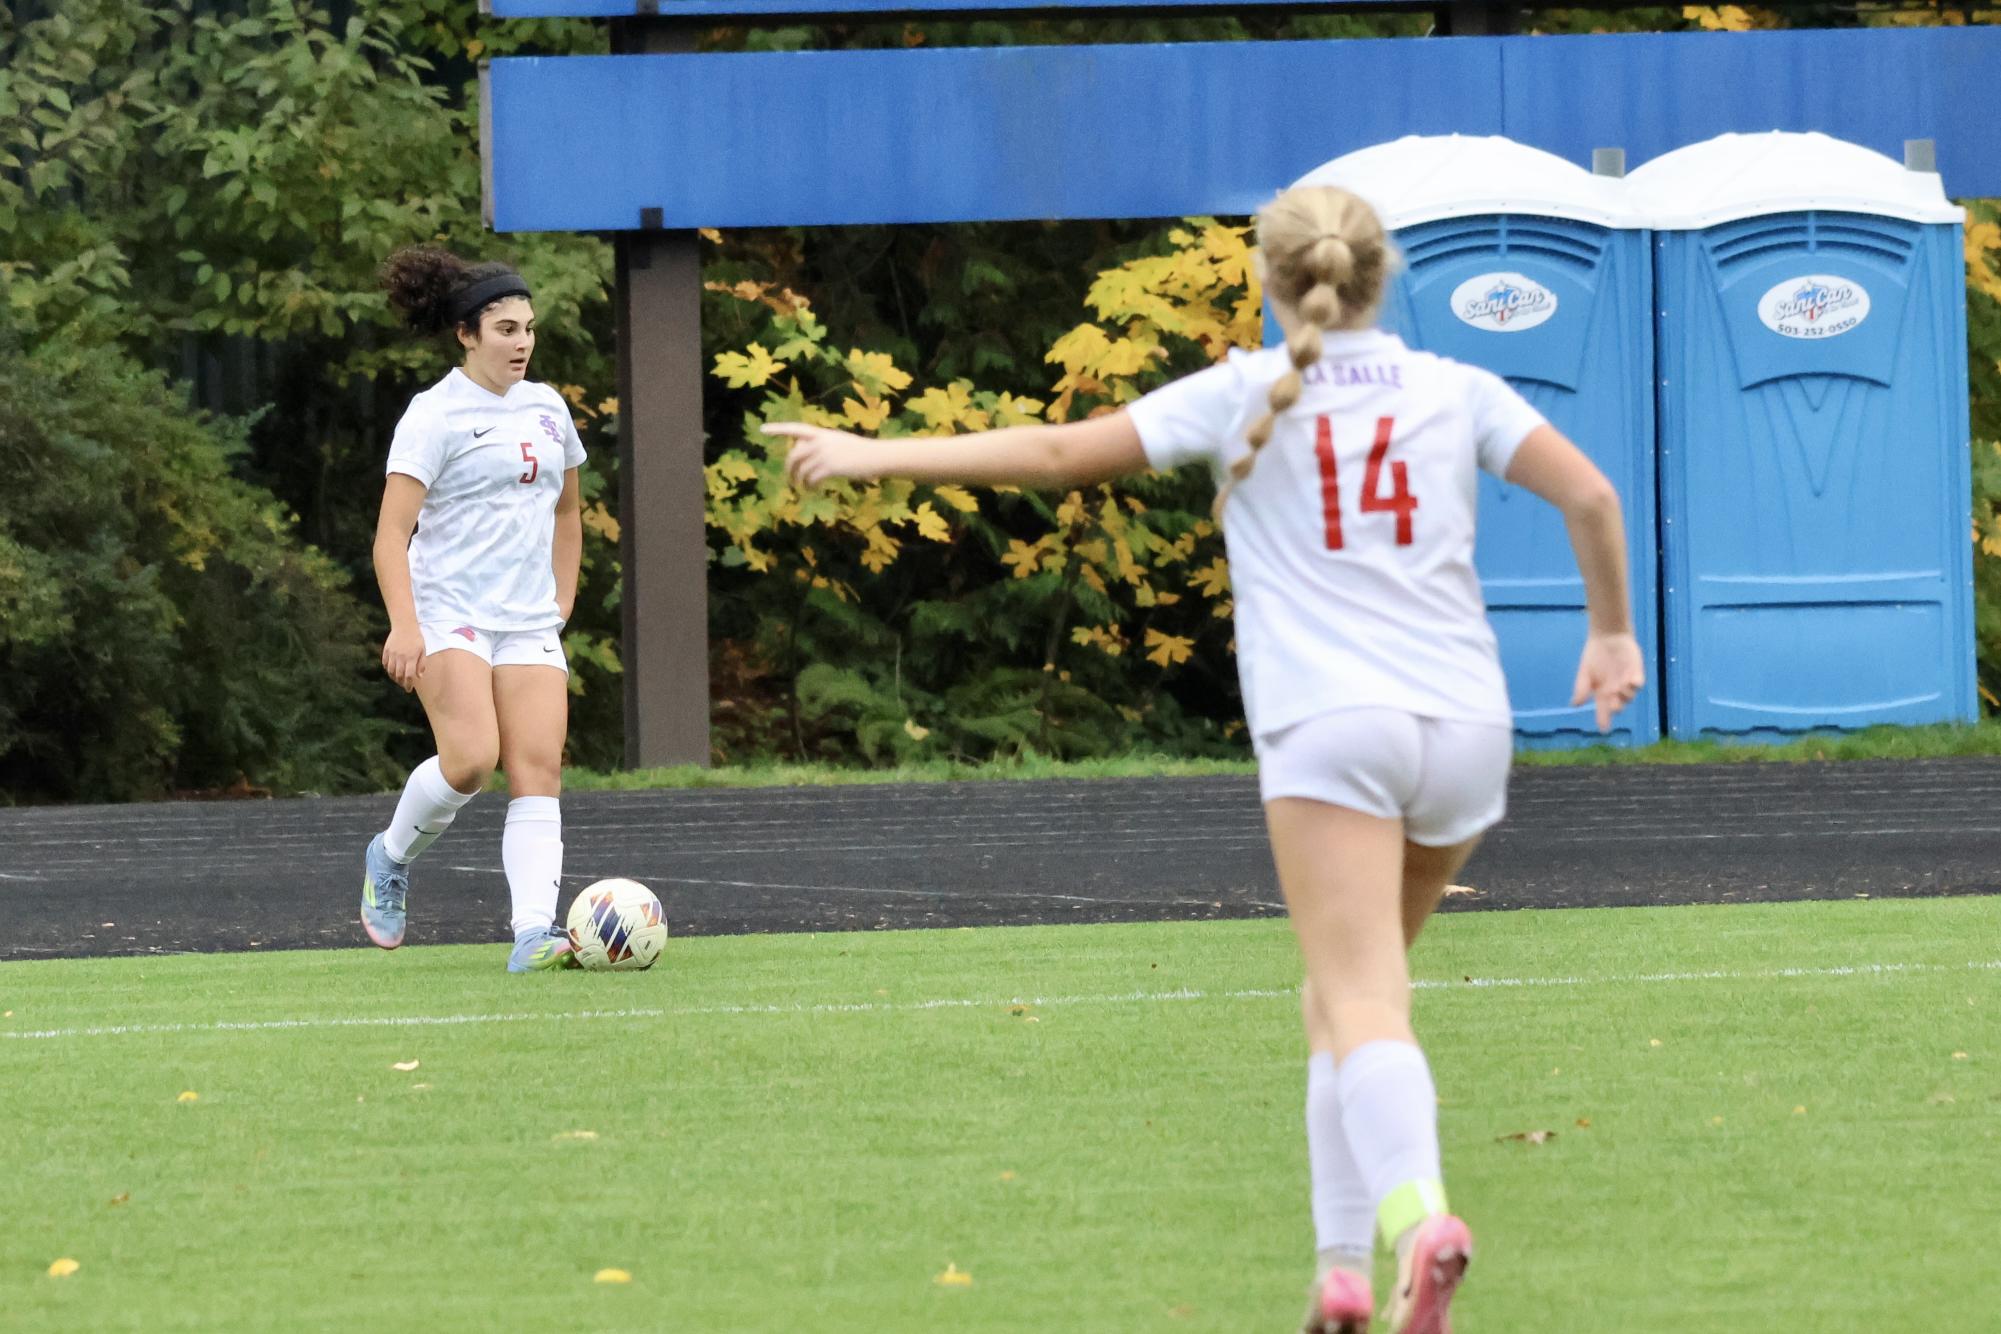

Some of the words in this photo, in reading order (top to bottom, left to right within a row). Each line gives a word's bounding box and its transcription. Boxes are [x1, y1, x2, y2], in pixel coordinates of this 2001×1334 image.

[1332, 364, 1404, 390] SALLE
[519, 442, 539, 484] 5
[1315, 413, 1418, 550] 14
